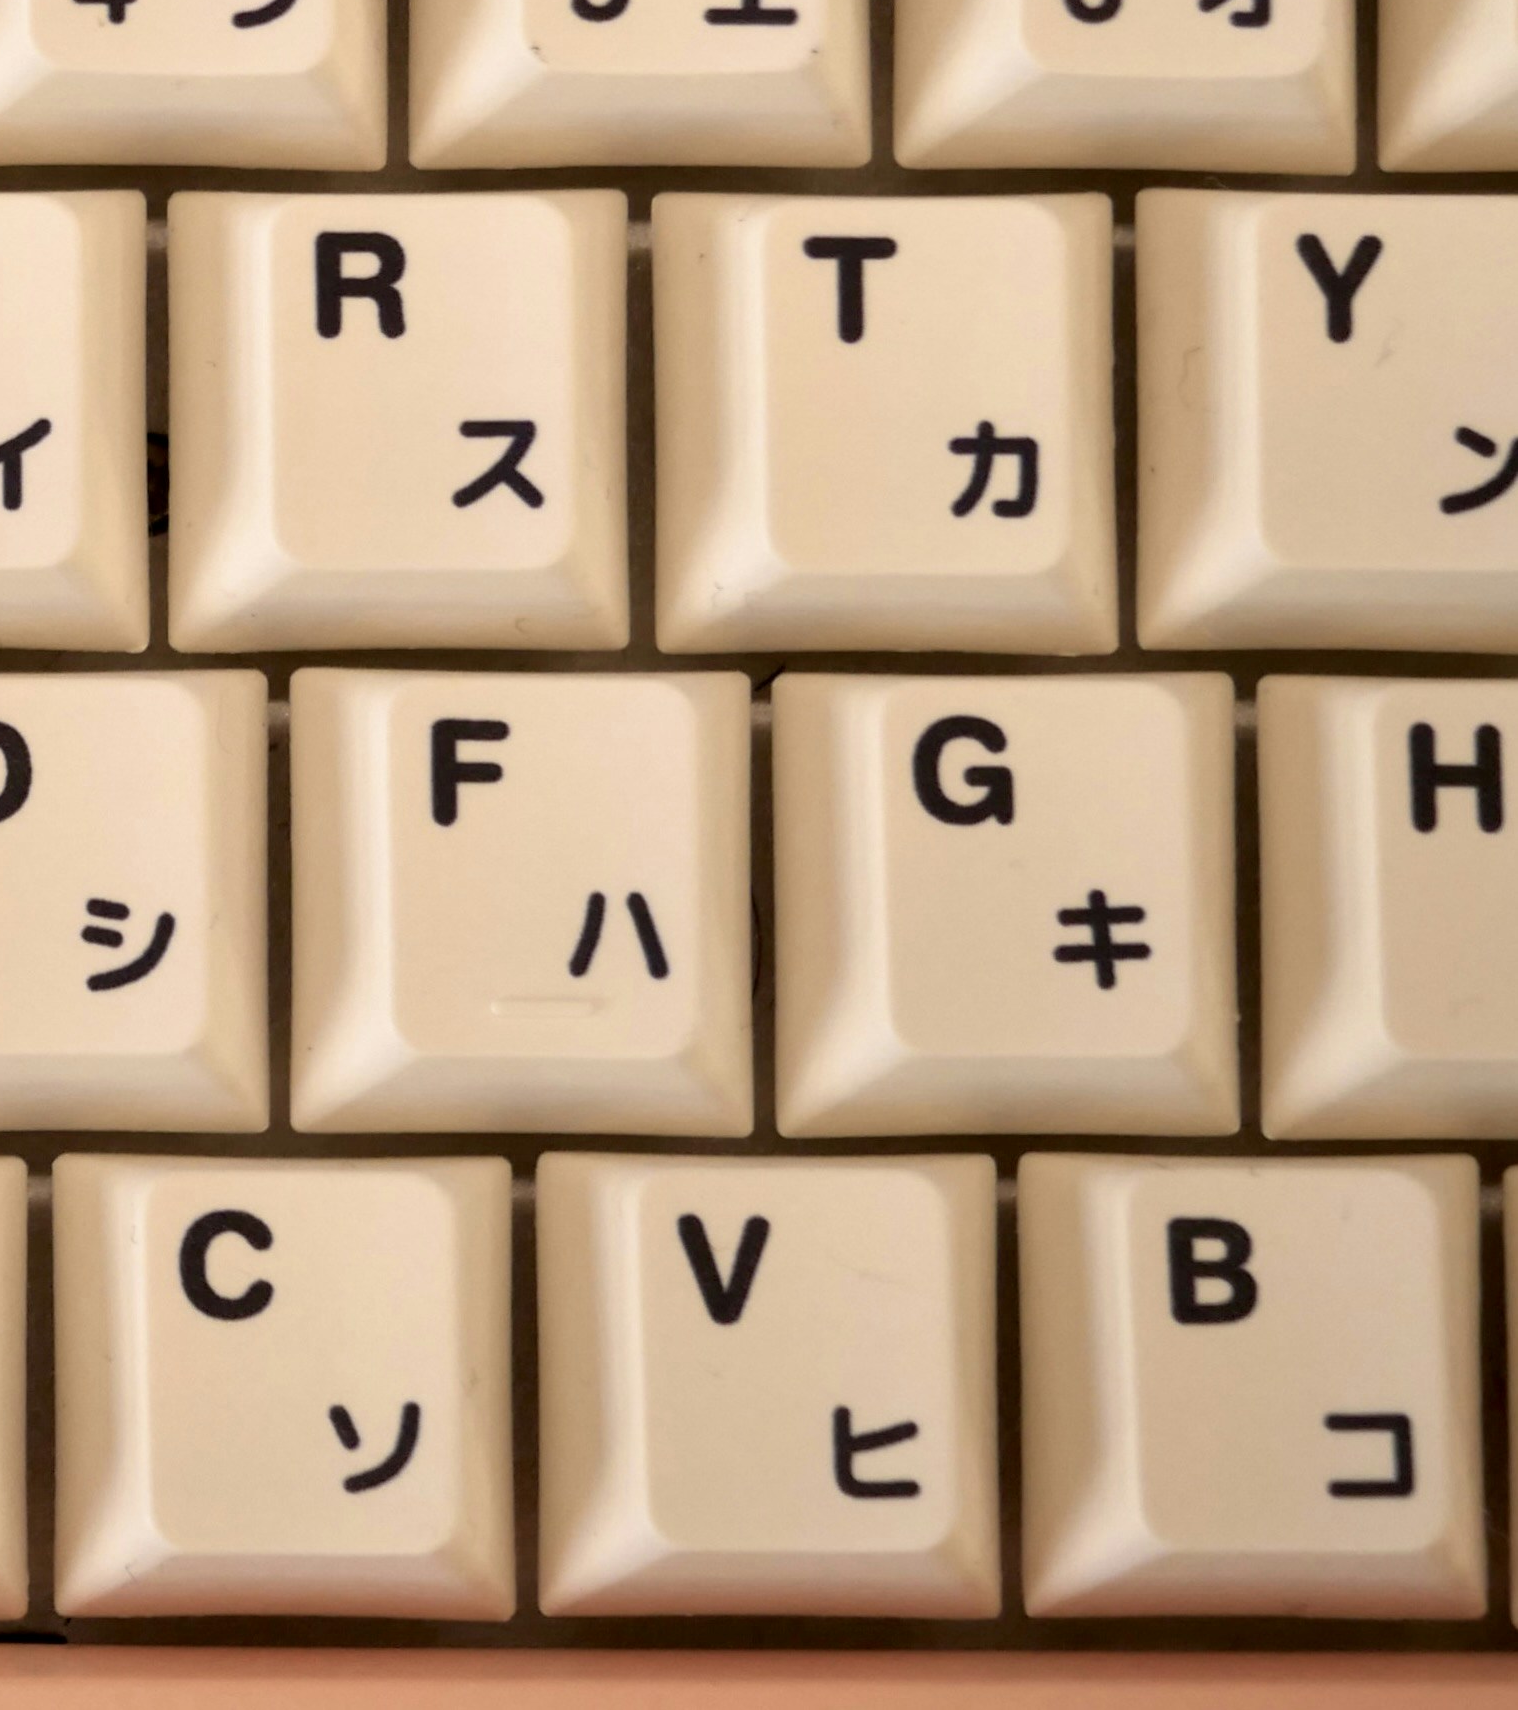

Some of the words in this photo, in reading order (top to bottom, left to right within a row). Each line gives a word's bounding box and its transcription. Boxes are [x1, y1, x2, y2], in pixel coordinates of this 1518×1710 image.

[314, 230, 407, 340] R
[802, 235, 898, 345] T
[1295, 232, 1384, 345] Y
[451, 419, 545, 510] ス
[948, 419, 1040, 519] カ
[430, 717, 511, 828] F
[911, 714, 1016, 827] G
[1407, 721, 1505, 835] H
[80, 897, 176, 993] シ
[568, 891, 670, 981] ハ
[1052, 888, 1153, 991] キ
[178, 1208, 275, 1322] C
[676, 1212, 771, 1327] V
[1165, 1216, 1260, 1327] B
[328, 1401, 422, 1495] ソ
[832, 1405, 922, 1501] ヒ
[1323, 1411, 1416, 1500] コ
